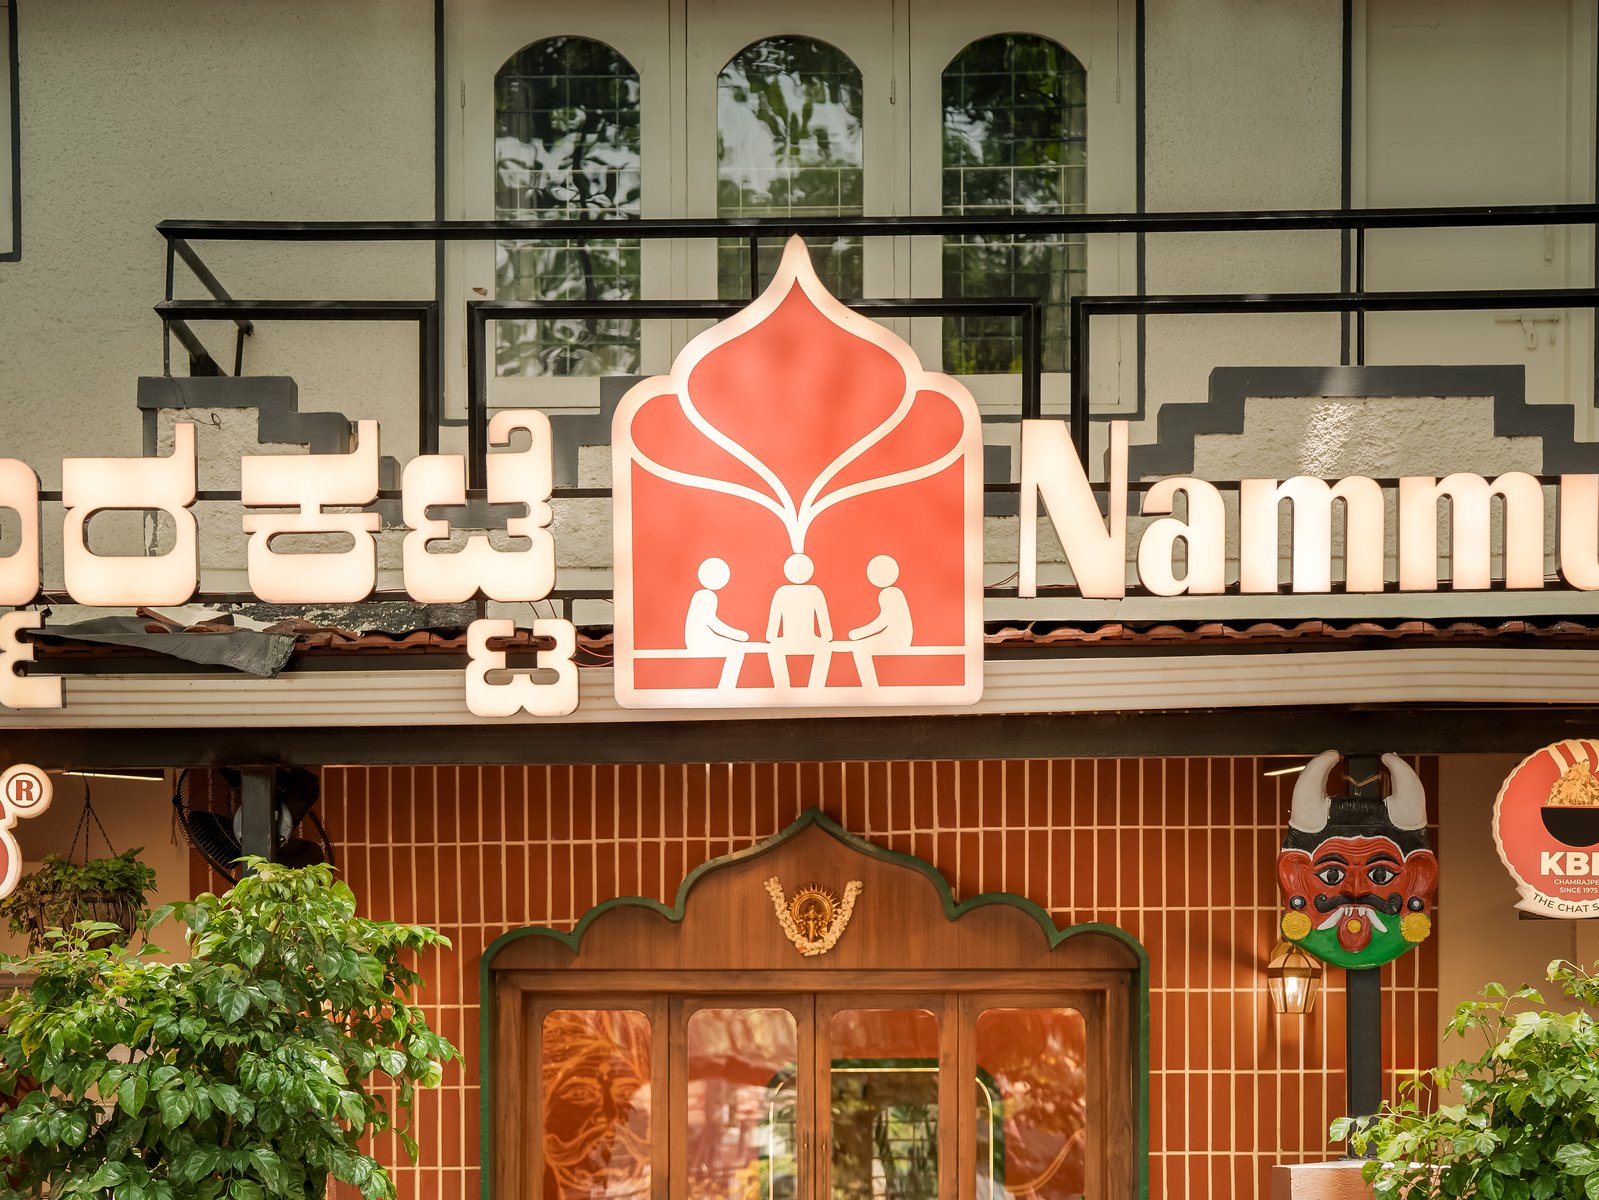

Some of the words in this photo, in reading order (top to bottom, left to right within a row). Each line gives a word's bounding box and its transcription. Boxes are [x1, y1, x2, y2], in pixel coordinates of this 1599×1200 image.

[1540, 851, 1599, 876] KB
[1533, 892, 1556, 909] THE
[1557, 903, 1590, 913] CHAT
